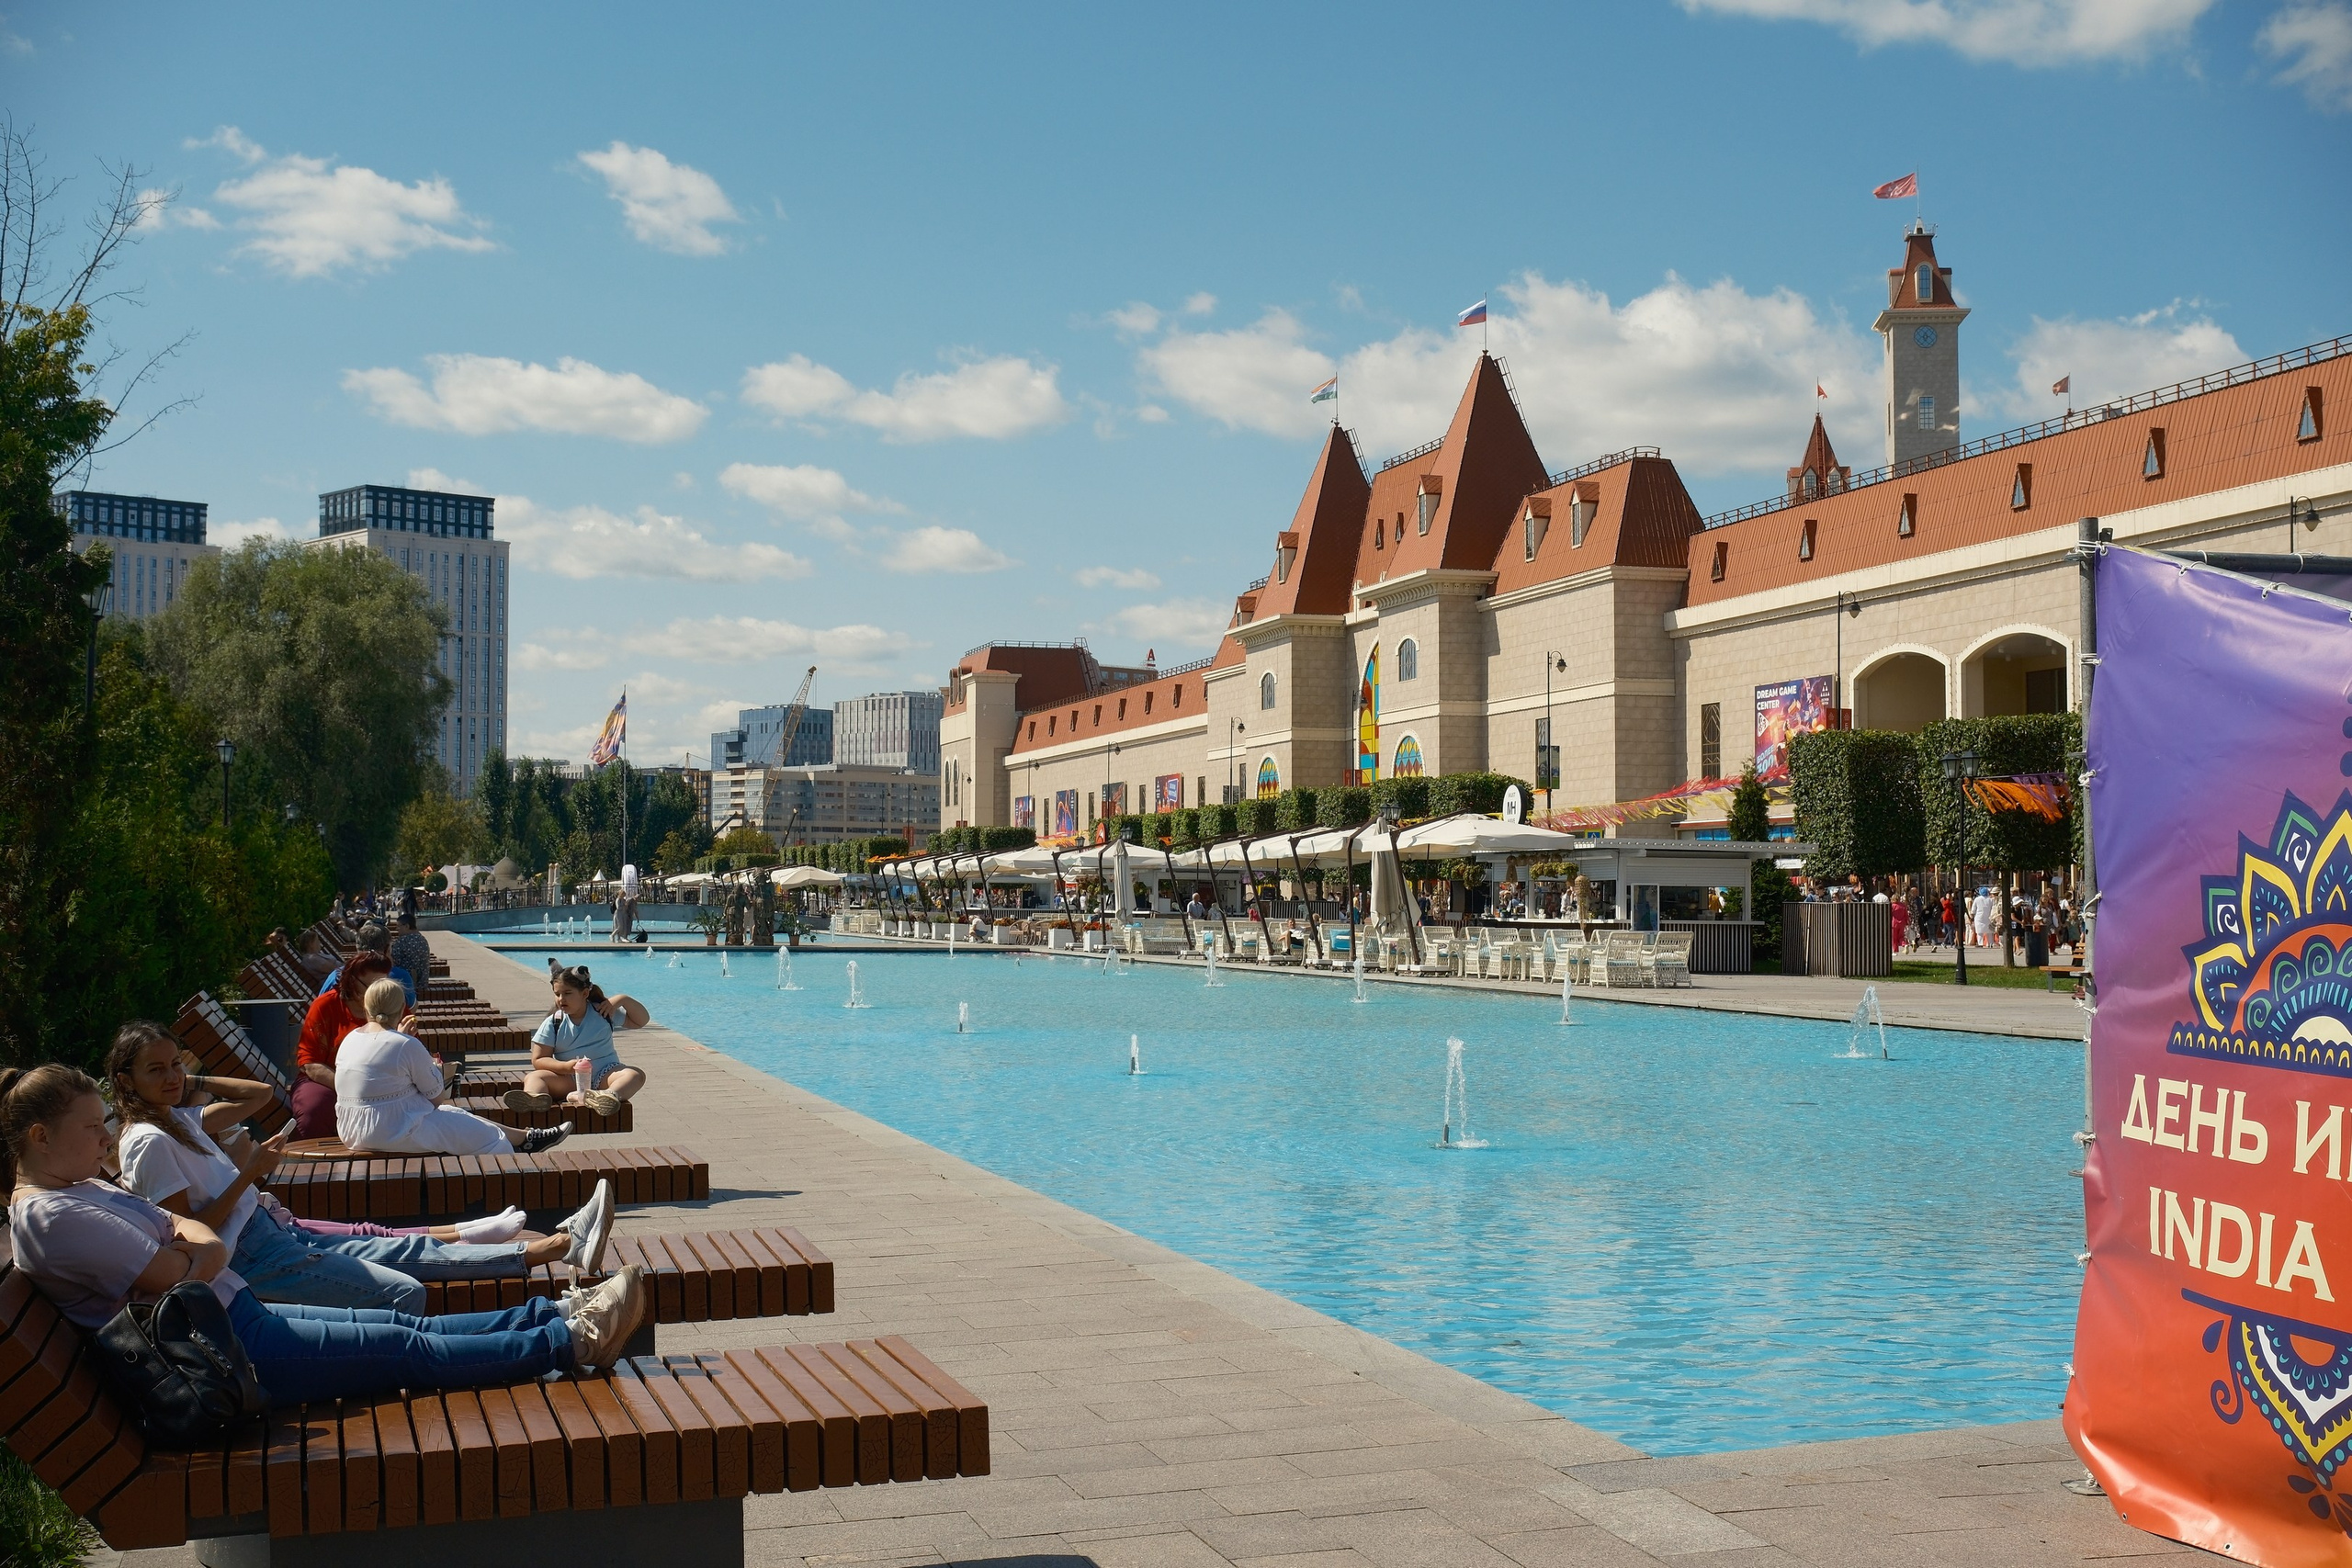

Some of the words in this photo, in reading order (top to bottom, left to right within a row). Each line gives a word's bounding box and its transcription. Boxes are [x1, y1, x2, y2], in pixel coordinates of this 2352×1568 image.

[1757, 687, 1778, 700] DREAM
[1779, 685, 1797, 695] GAME
[1757, 699, 1780, 710] CENTER
[1507, 801, 1516, 815] MH
[2120, 1074, 2268, 1166] ДЕНЬ
[2292, 1100, 2352, 1183] И
[2149, 1186, 2335, 1303] INDIA
